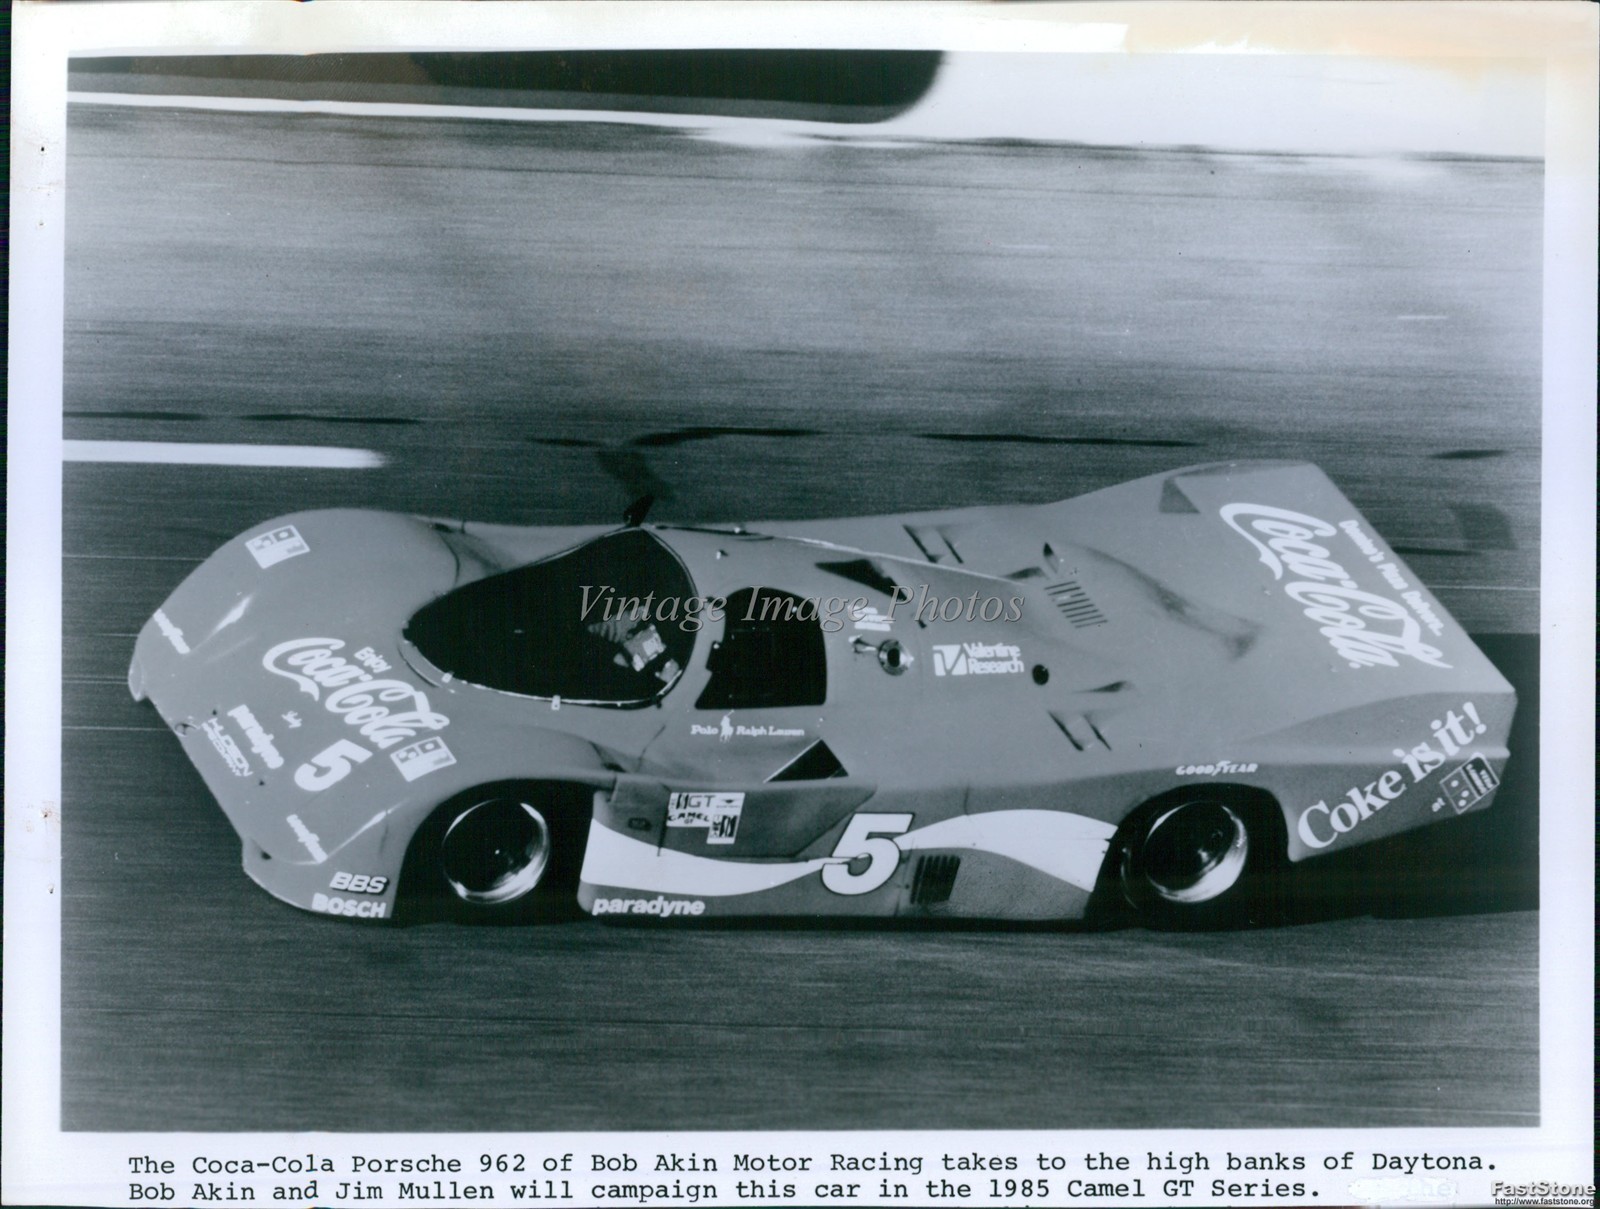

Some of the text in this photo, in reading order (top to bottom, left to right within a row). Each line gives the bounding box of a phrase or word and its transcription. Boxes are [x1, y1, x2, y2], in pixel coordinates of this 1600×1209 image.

[1220, 502, 1454, 669] Coca-Cola
[354, 646, 392, 674] Enjoy
[963, 641, 1022, 659] Valentine
[967, 656, 1025, 675] Research
[262, 637, 451, 750] Coca-Cola
[690, 724, 806, 738] Polo Ralph Lauren
[207, 717, 254, 777] HUDSON
[293, 738, 373, 792] 5
[1175, 760, 1258, 777] GOODYEAR
[1297, 769, 1407, 849] Coke
[1392, 742, 1447, 784] is
[1430, 701, 1488, 757] it!
[668, 811, 711, 823] CAMEL
[820, 812, 915, 896] 5
[329, 870, 388, 895] BBS
[311, 892, 387, 919] BOSCH
[591, 895, 706, 918] paradyne
